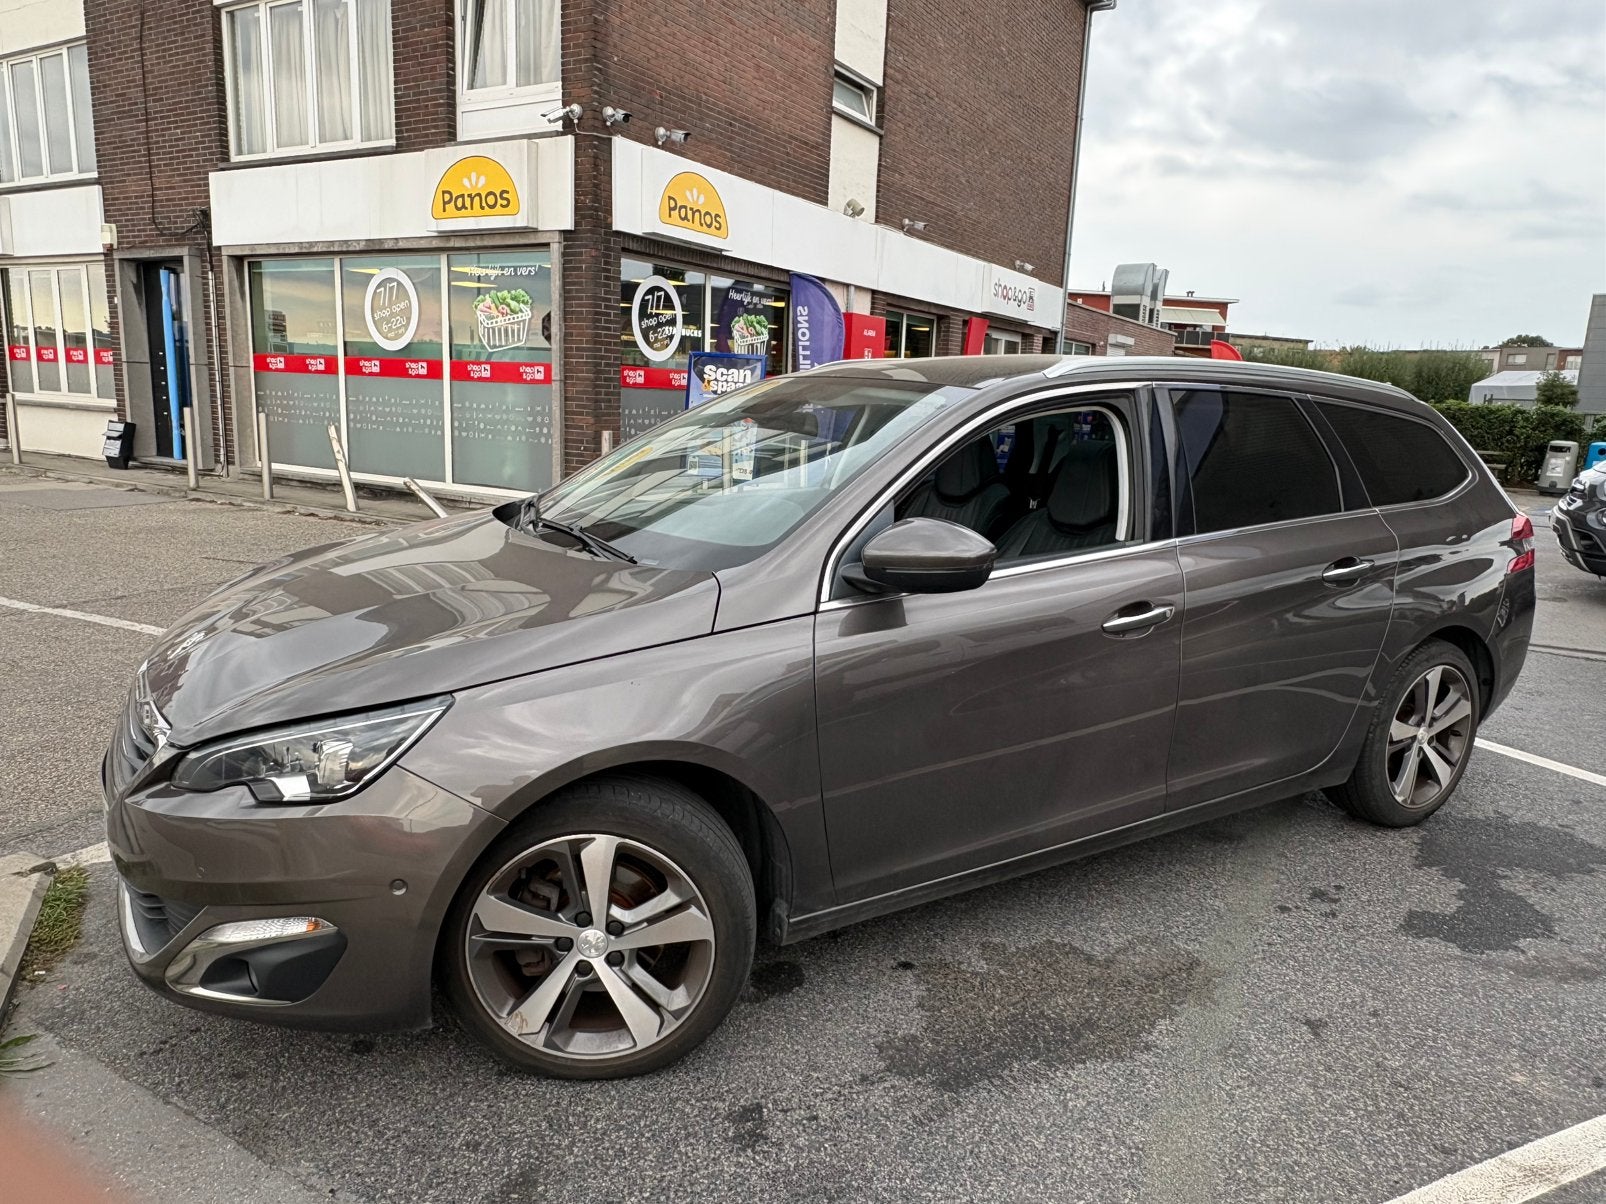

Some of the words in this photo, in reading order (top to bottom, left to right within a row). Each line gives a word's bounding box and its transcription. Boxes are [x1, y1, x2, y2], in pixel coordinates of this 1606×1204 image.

[442, 189, 511, 213] Panos
[668, 195, 722, 231] Panos
[504, 267, 515, 276] en
[517, 263, 539, 276] vers!
[376, 281, 397, 307] 7/7
[644, 290, 665, 315] 7/7
[728, 288, 752, 306] Heerlijk
[752, 296, 760, 304] en
[374, 308, 391, 321] shop
[391, 300, 410, 313] open
[641, 317, 658, 329] shop
[658, 312, 676, 324] open
[703, 364, 752, 385] Scan
